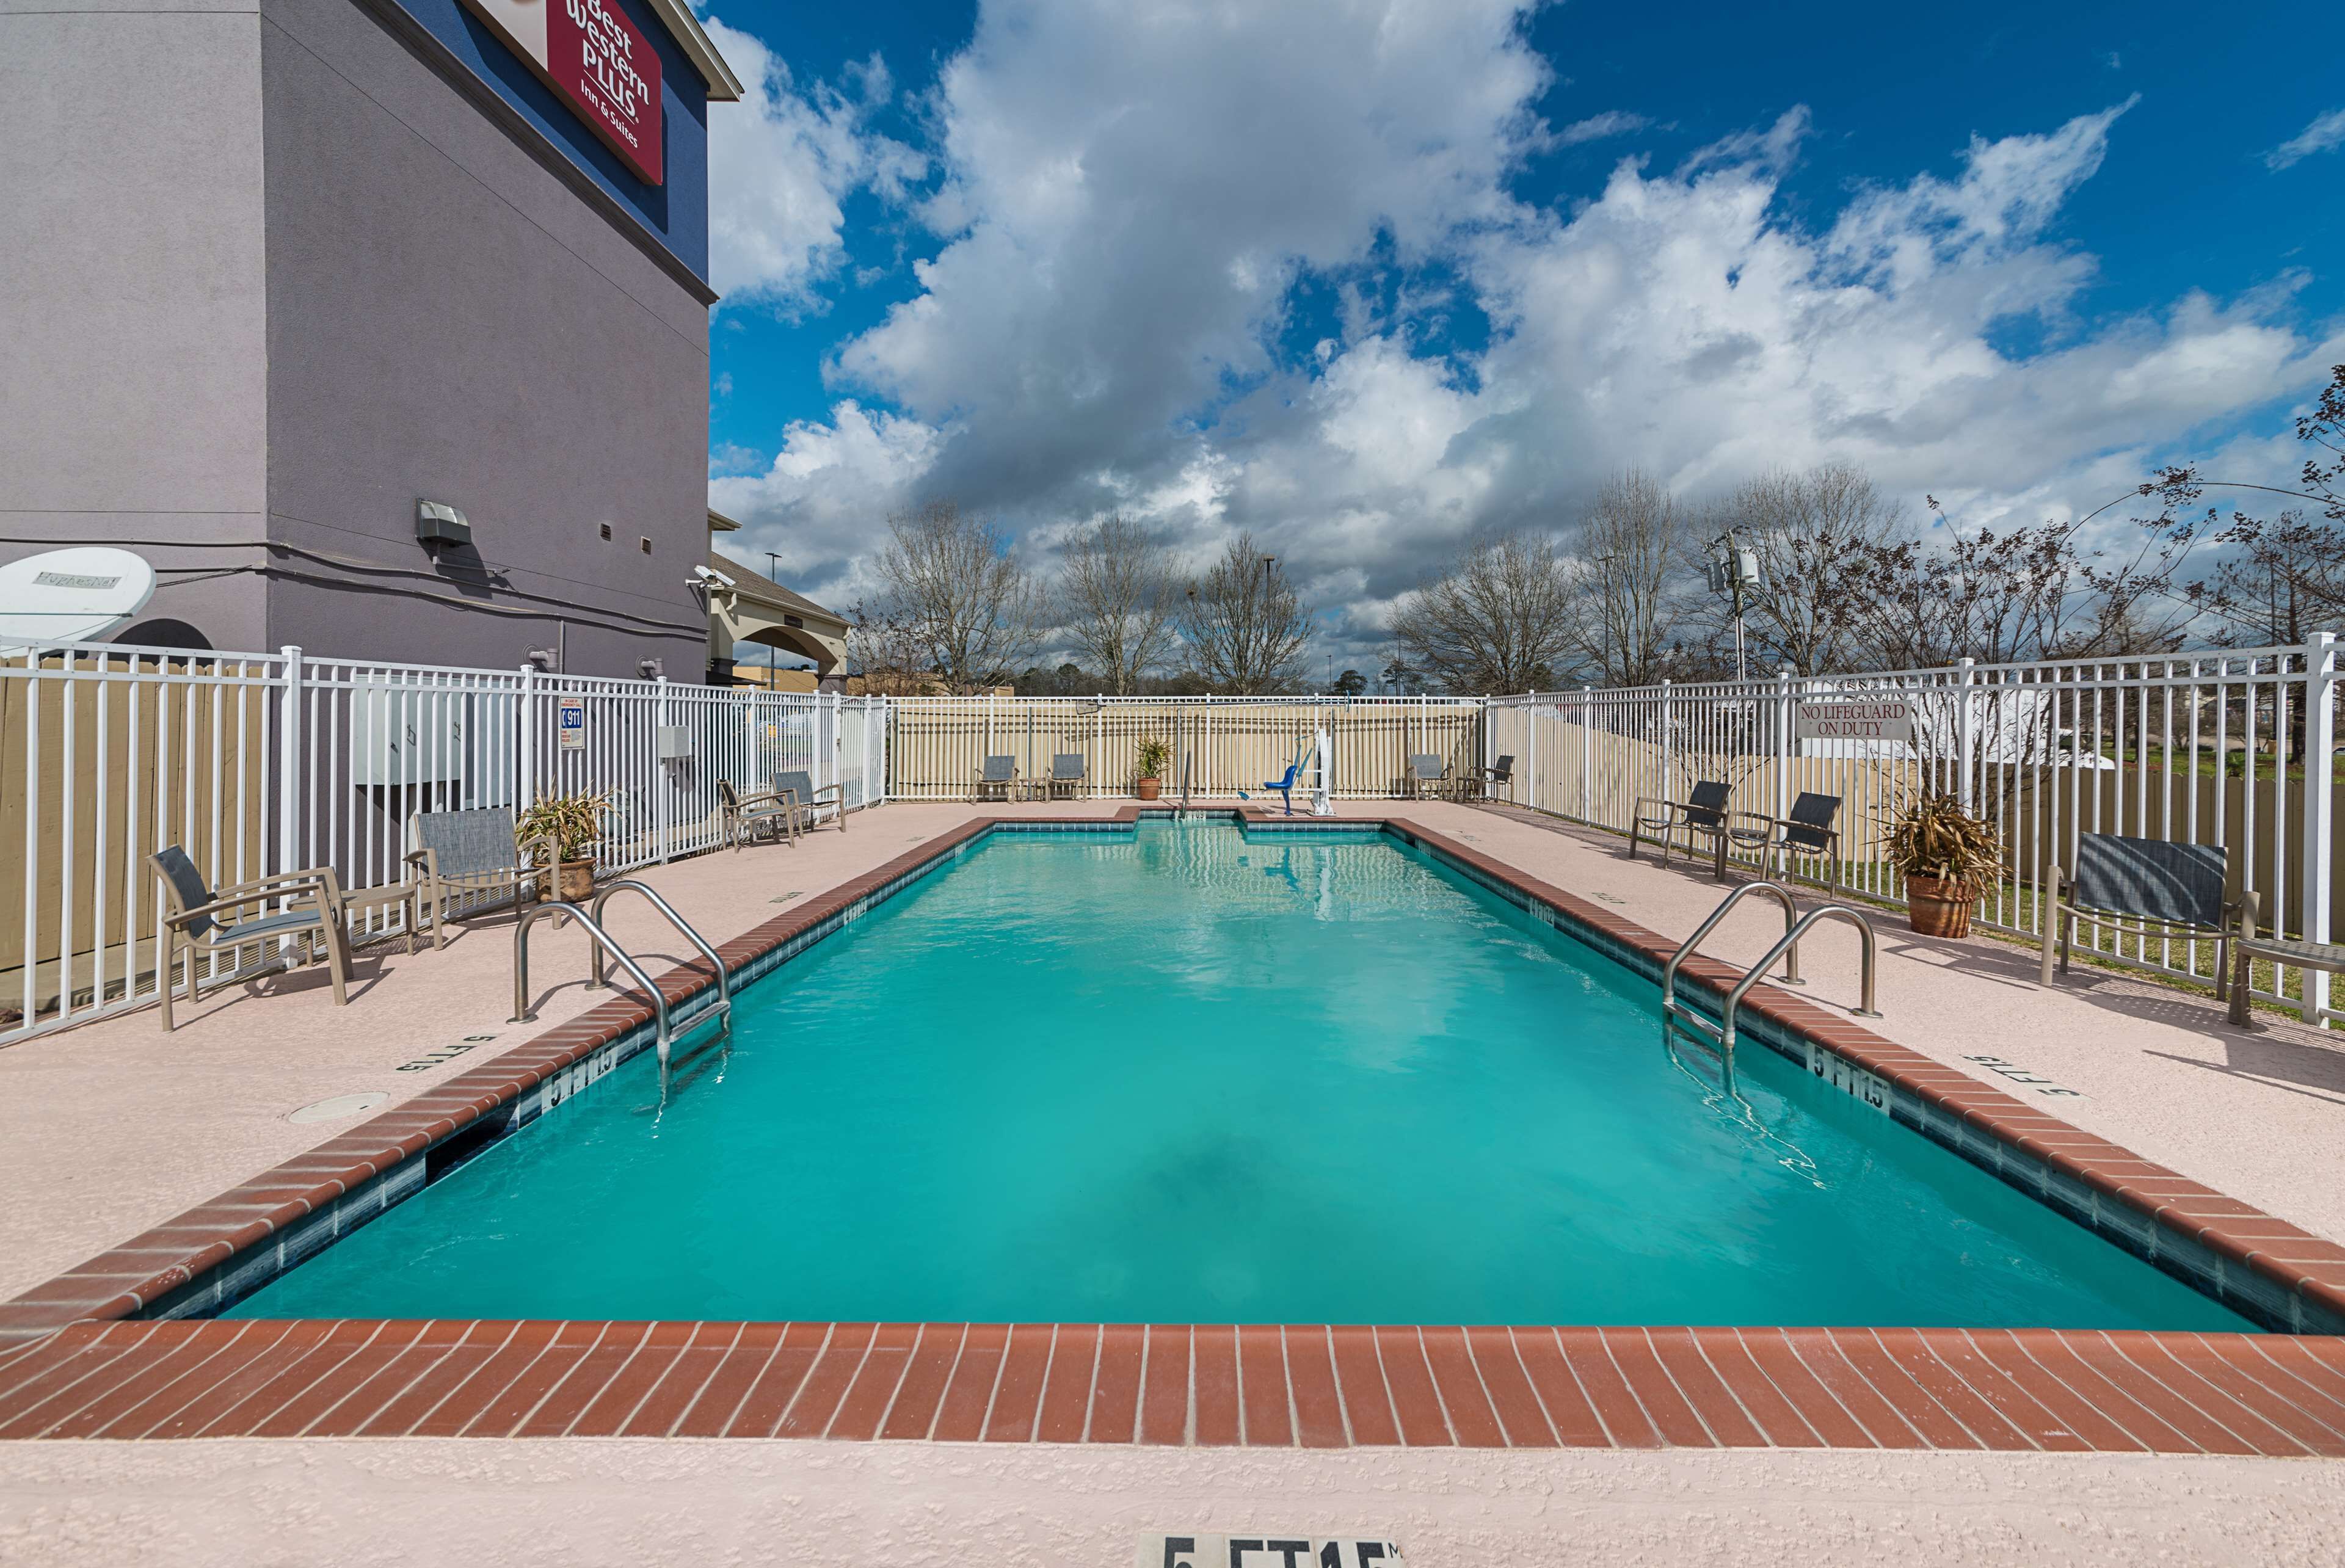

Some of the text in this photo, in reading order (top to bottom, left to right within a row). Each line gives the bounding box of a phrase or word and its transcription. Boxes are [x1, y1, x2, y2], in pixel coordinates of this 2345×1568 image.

[588, 0, 633, 59] Best
[566, 0, 649, 105] Western
[581, 79, 638, 148] Inn & Suites
[36, 572, 117, 587] HughesNet
[567, 710, 580, 725] 911
[1801, 704, 1905, 719] NO LIFEGUARD
[1818, 722, 1883, 736] ON DUTY
